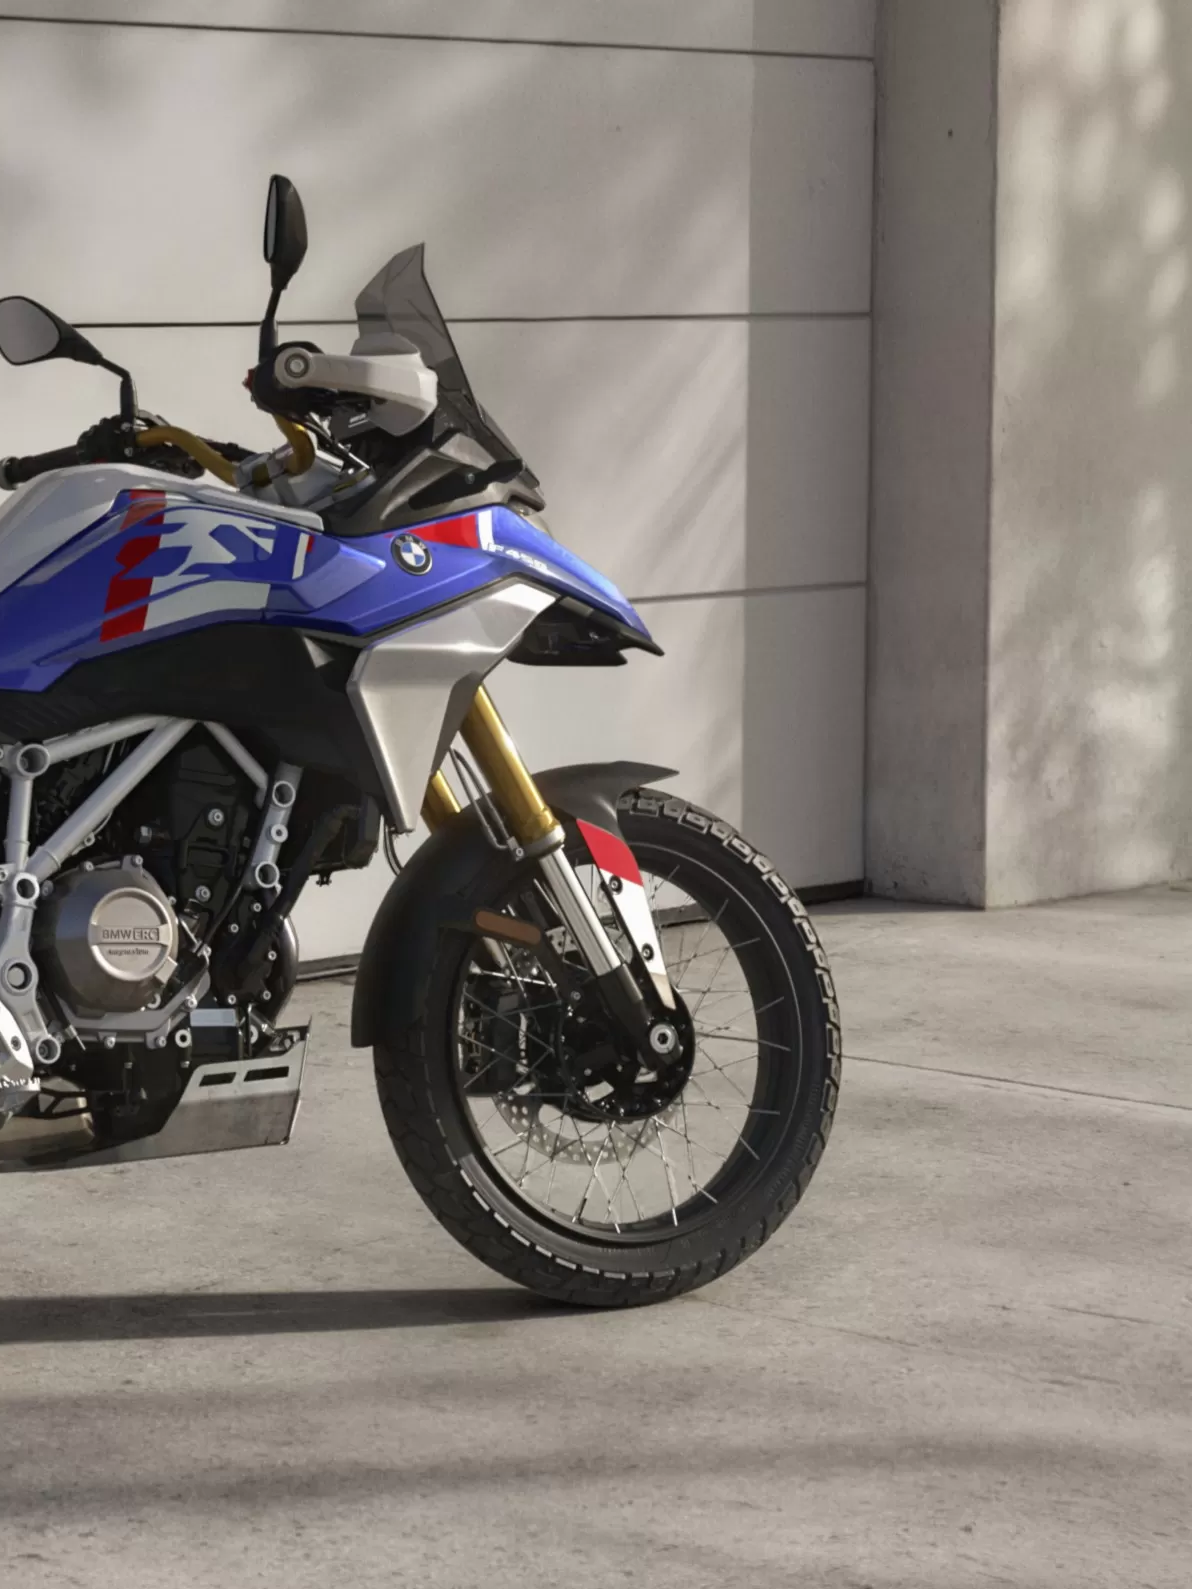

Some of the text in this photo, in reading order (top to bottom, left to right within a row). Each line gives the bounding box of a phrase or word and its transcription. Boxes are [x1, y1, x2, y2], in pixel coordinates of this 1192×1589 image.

[394, 535, 427, 550] BMW
[489, 543, 505, 552] F
[102, 929, 132, 940] BMW
